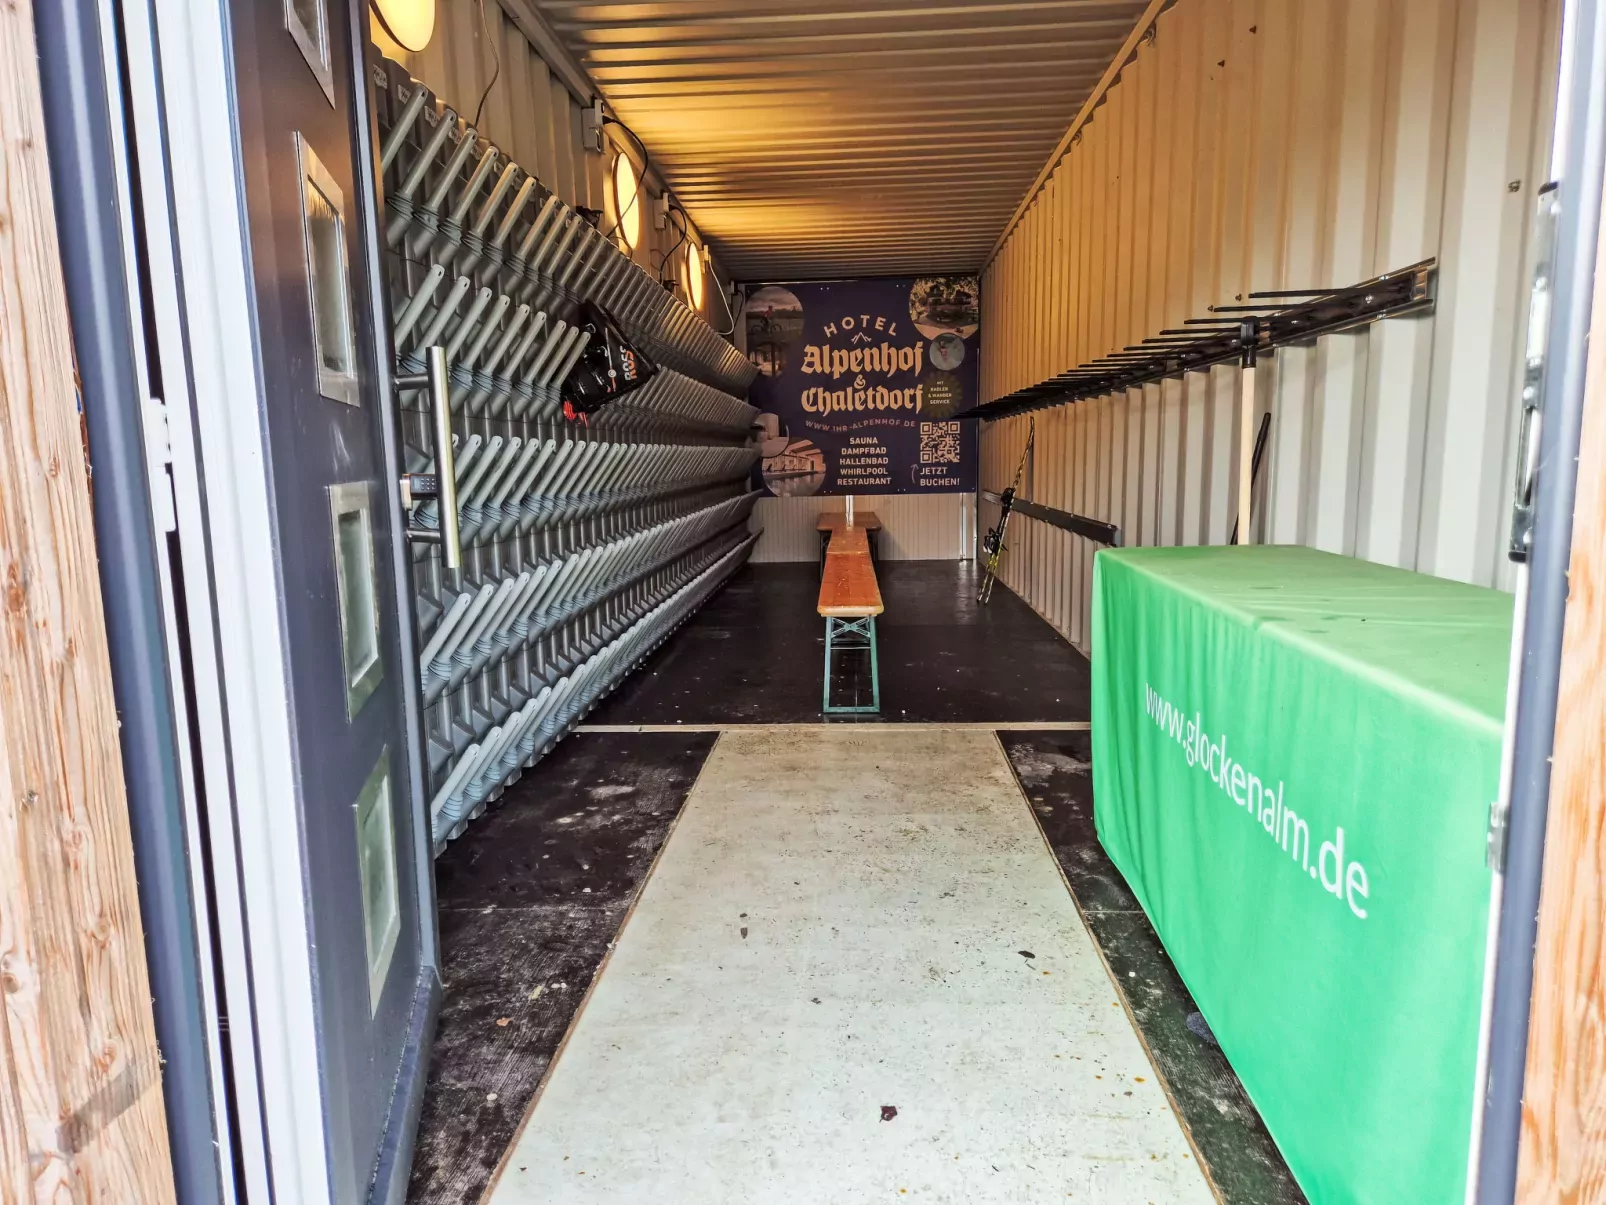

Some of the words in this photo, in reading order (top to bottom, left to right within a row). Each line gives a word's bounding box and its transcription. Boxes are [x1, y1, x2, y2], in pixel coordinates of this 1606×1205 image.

[824, 315, 897, 338] HOTEL
[801, 341, 923, 379] Alpenhof
[854, 374, 866, 389] &
[801, 384, 923, 417] Chaletdorf
[805, 418, 917, 432] WWW.IHR-ALPENHOF.DE
[849, 437, 879, 445] SAUNA
[841, 447, 887, 455] DAMPFBAD
[839, 457, 889, 465] HALLENBAD
[840, 467, 889, 475] WHIRLPOOL
[920, 467, 948, 475] JETZT
[837, 477, 892, 486] RESTAURANT
[920, 478, 960, 487] BUCHEN!
[1145, 682, 1369, 920] www.glockenalm.de
